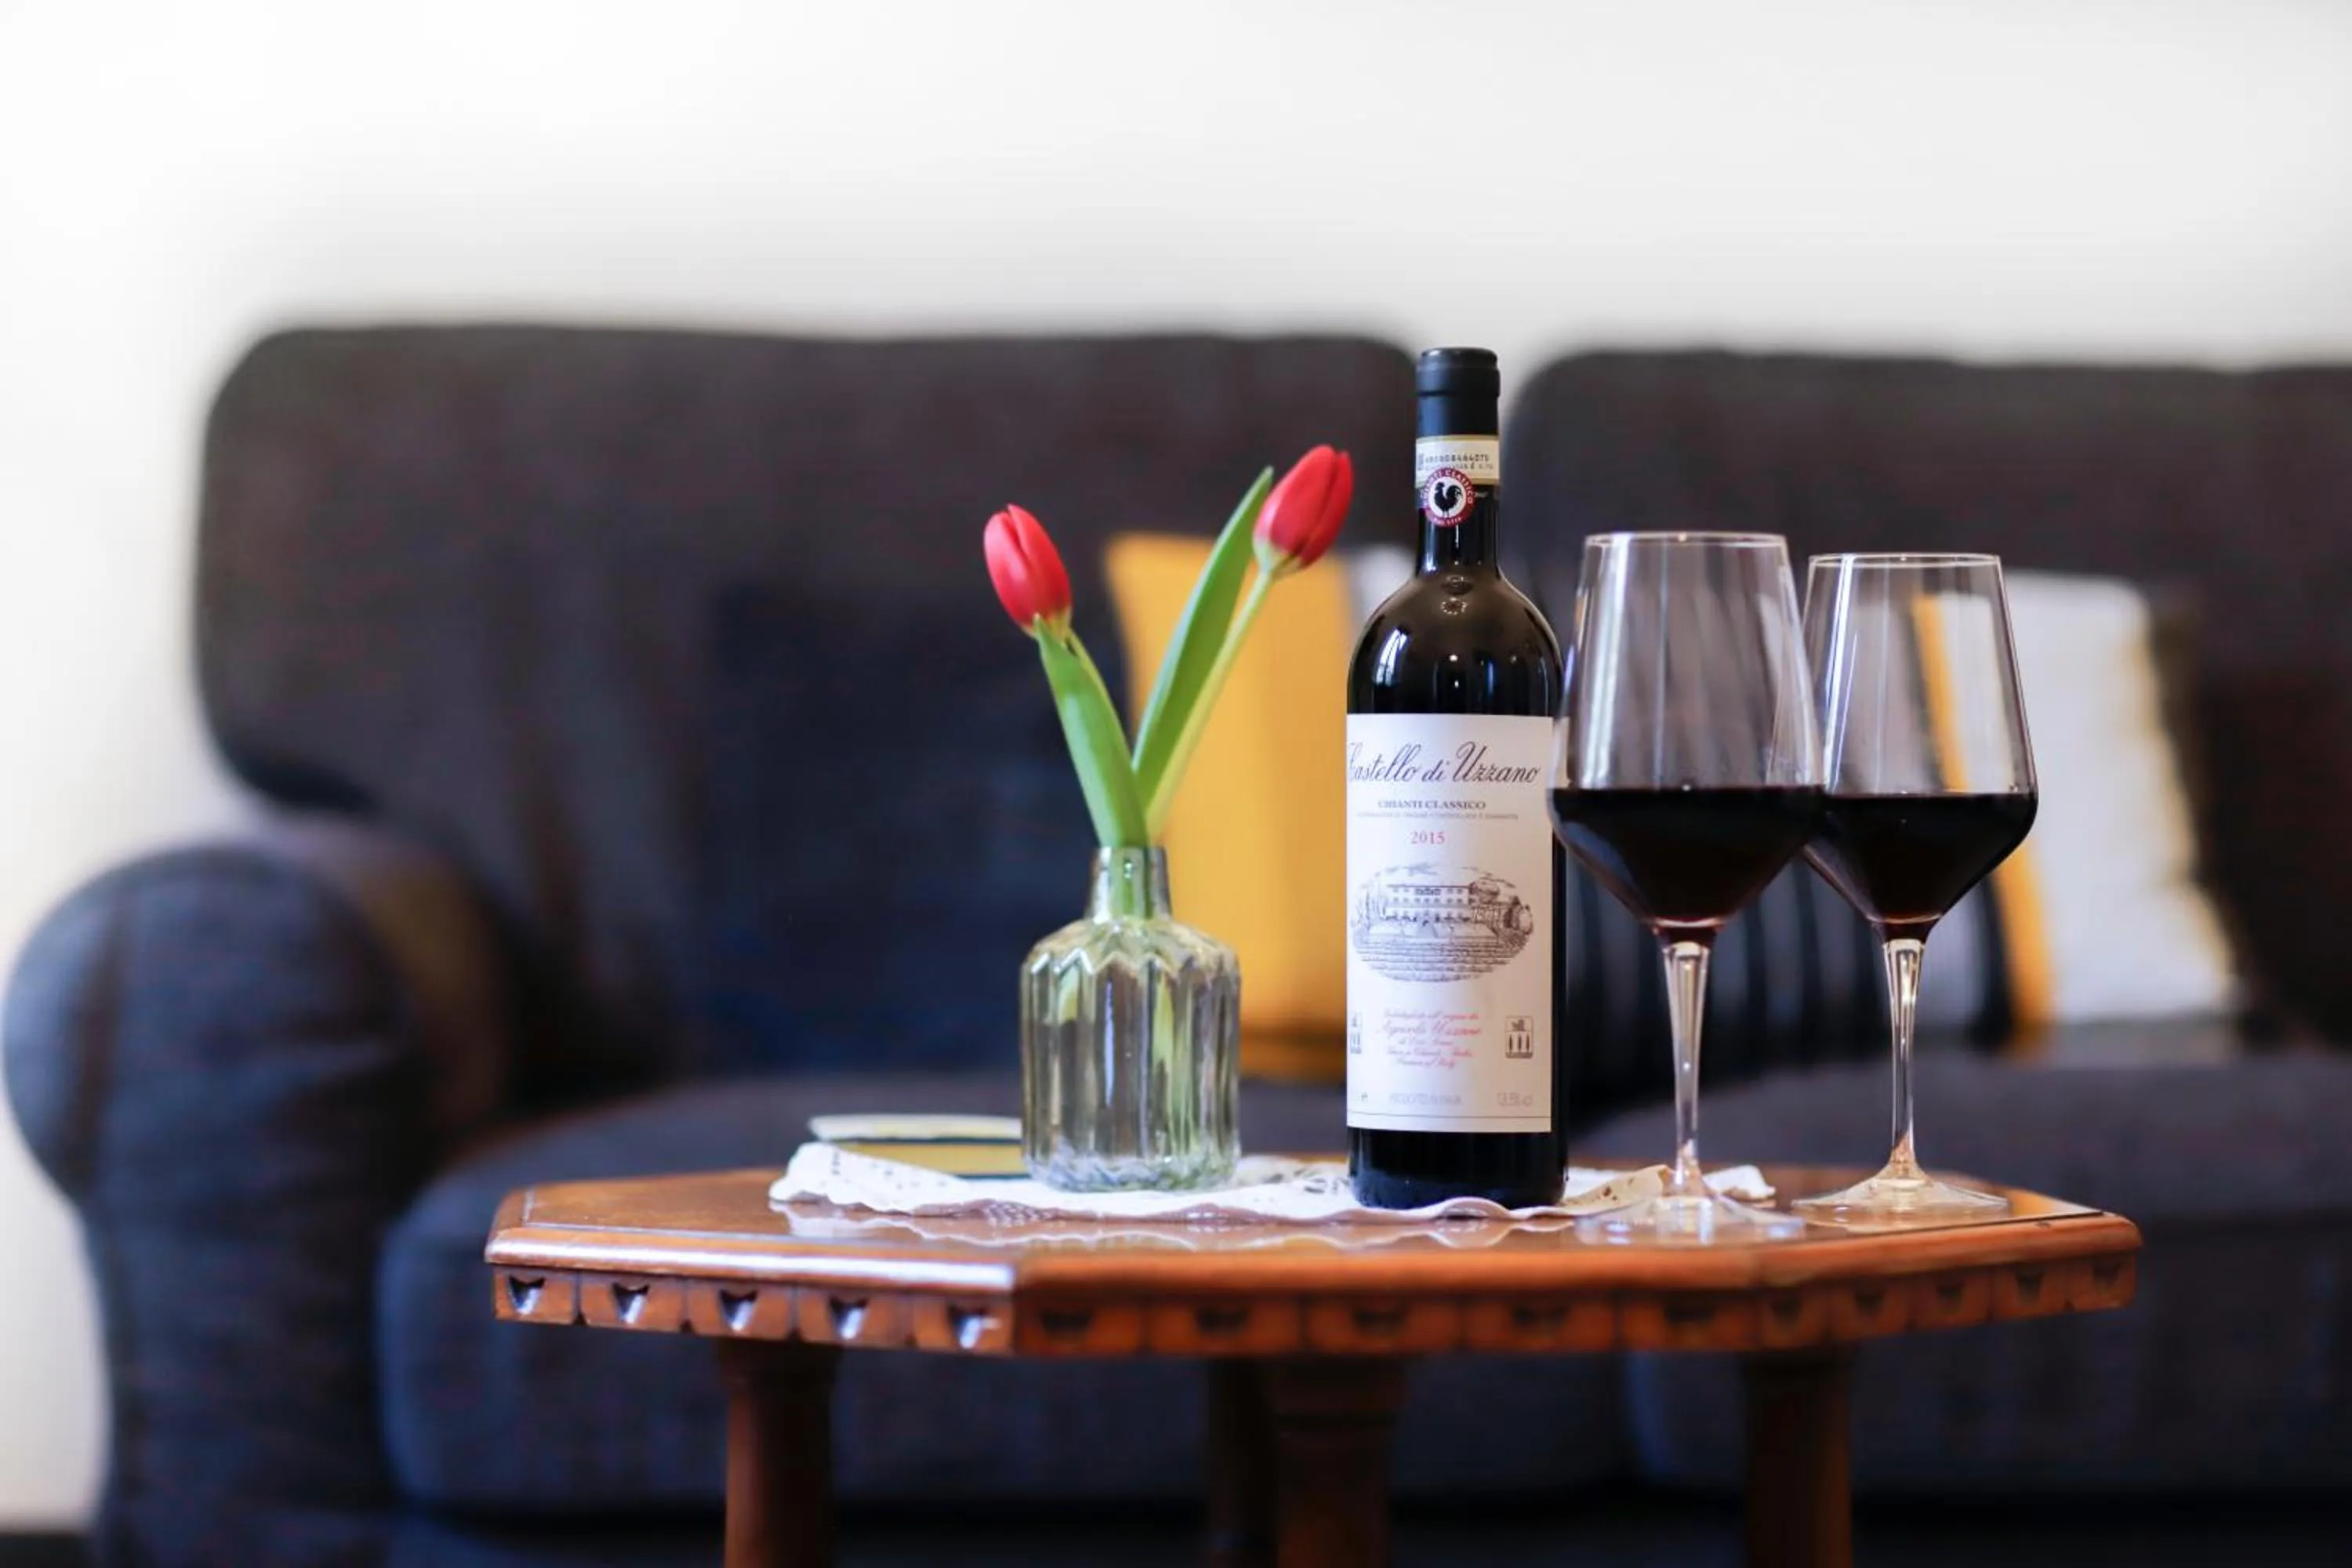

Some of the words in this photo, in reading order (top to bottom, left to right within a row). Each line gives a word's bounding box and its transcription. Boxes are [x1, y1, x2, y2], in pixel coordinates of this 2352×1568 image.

[1421, 759, 1450, 782] di
[1453, 741, 1541, 783] Uzzano
[1377, 799, 1423, 809] CHIANTI
[1425, 800, 1486, 810] CLASSICO
[1410, 831, 1446, 845] 2015
